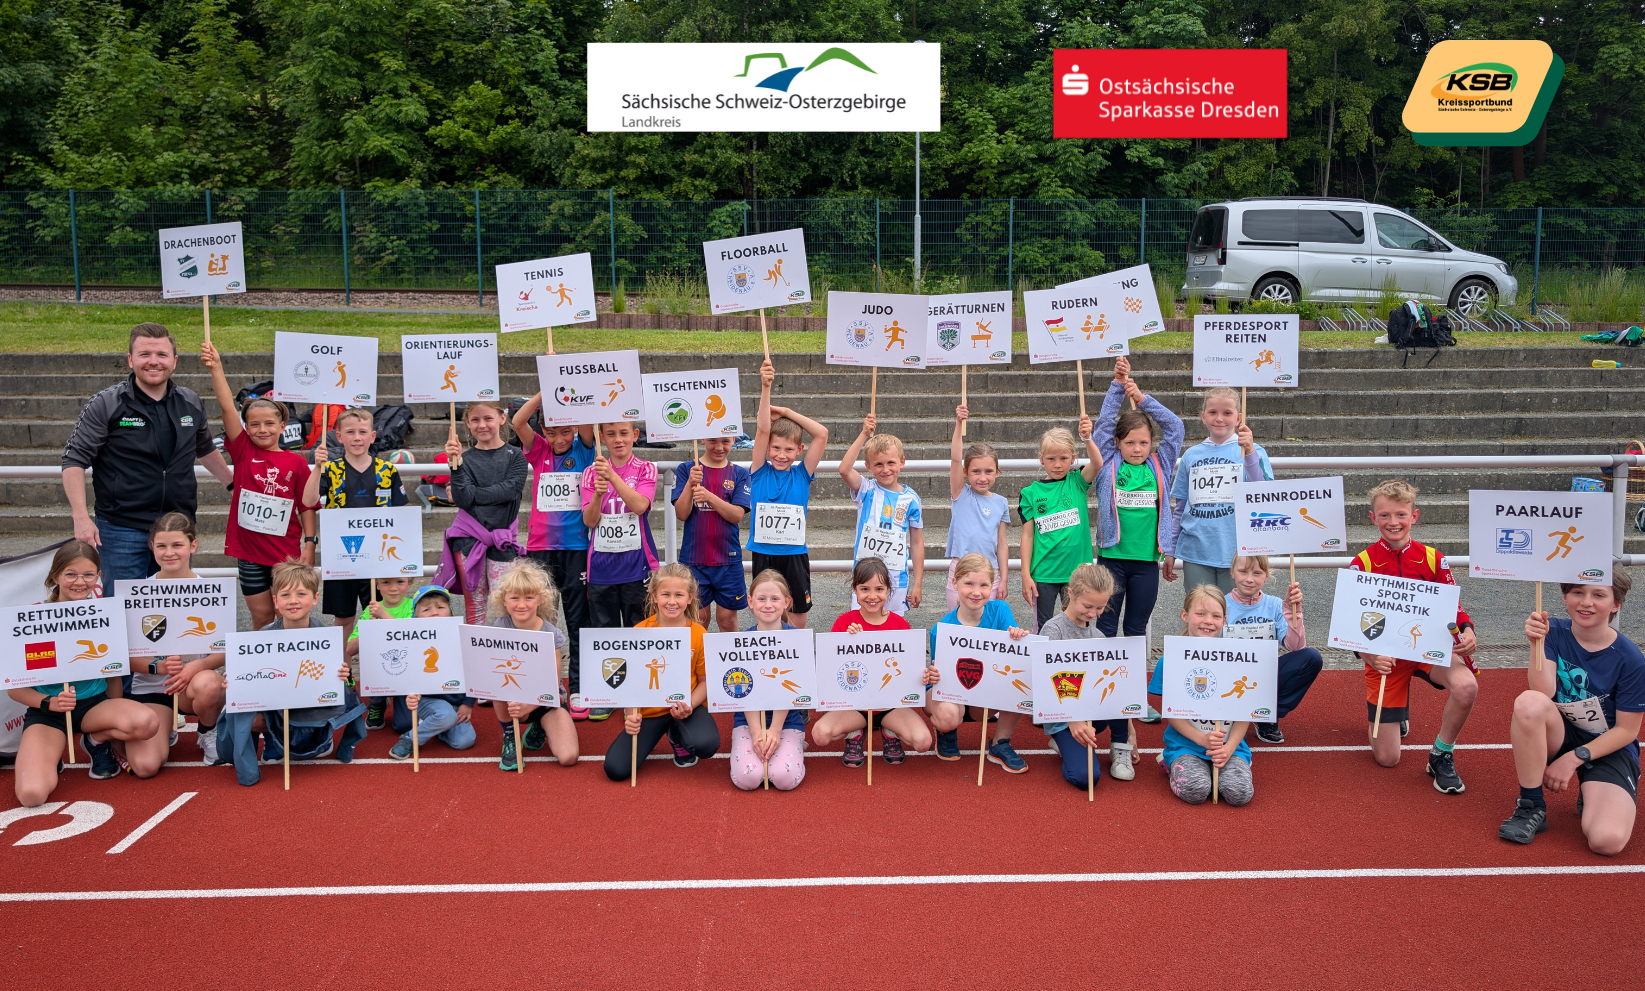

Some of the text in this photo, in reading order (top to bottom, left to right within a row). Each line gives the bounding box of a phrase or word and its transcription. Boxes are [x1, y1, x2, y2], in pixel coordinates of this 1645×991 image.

[164, 234, 237, 249] DRACHENBOOT
[720, 242, 789, 261] FLOORBALL
[523, 267, 564, 281] TENNIS
[861, 304, 893, 315] JUDO
[1051, 296, 1098, 311] RUDERN
[1204, 321, 1289, 331] PFERDESPORT
[405, 339, 494, 350] ORIENTIERUNGS-
[1225, 333, 1267, 343] REITEN
[310, 344, 343, 355] GOLF
[437, 351, 463, 360] LAUF
[559, 362, 619, 376] FUSSBALL
[652, 379, 727, 393] TISCHTENNIS
[570, 394, 594, 403] KVF
[1192, 475, 1238, 490] 1047-1
[540, 483, 581, 498] 1008-1
[1245, 488, 1332, 504] RENNRODELN
[241, 501, 286, 522] 1010-1
[1495, 504, 1583, 519] PAARLAUF
[348, 518, 394, 529] KEGELN
[759, 515, 801, 530] 1077-1
[596, 523, 637, 539] 1008-2
[863, 535, 904, 556] 1077-2
[130, 583, 222, 596] SCHWIMMEN
[1356, 574, 1440, 595] RHYTHMISCHE
[125, 596, 228, 609] BREITENSPORT
[1376, 589, 1416, 603] SPORT
[17, 604, 103, 623] RETTUNGS-
[1359, 597, 1431, 617] GYMNASTIK
[12, 617, 110, 637] SCHWIMMEN
[152, 630, 160, 639] F
[385, 629, 437, 641] SCHACH
[734, 635, 782, 648] BEACH-
[238, 639, 331, 655] SLOT RACING
[470, 636, 539, 653] BADMINTON
[593, 639, 682, 651] BOGENSPORT
[837, 642, 905, 655] HANDBALL
[948, 635, 1031, 657] VOLLEYBALL
[718, 648, 800, 663] VOLLEYBALL
[1045, 649, 1129, 664] BASKETBALL
[1184, 649, 1259, 663] FAUSTBALL
[612, 675, 620, 685] F
